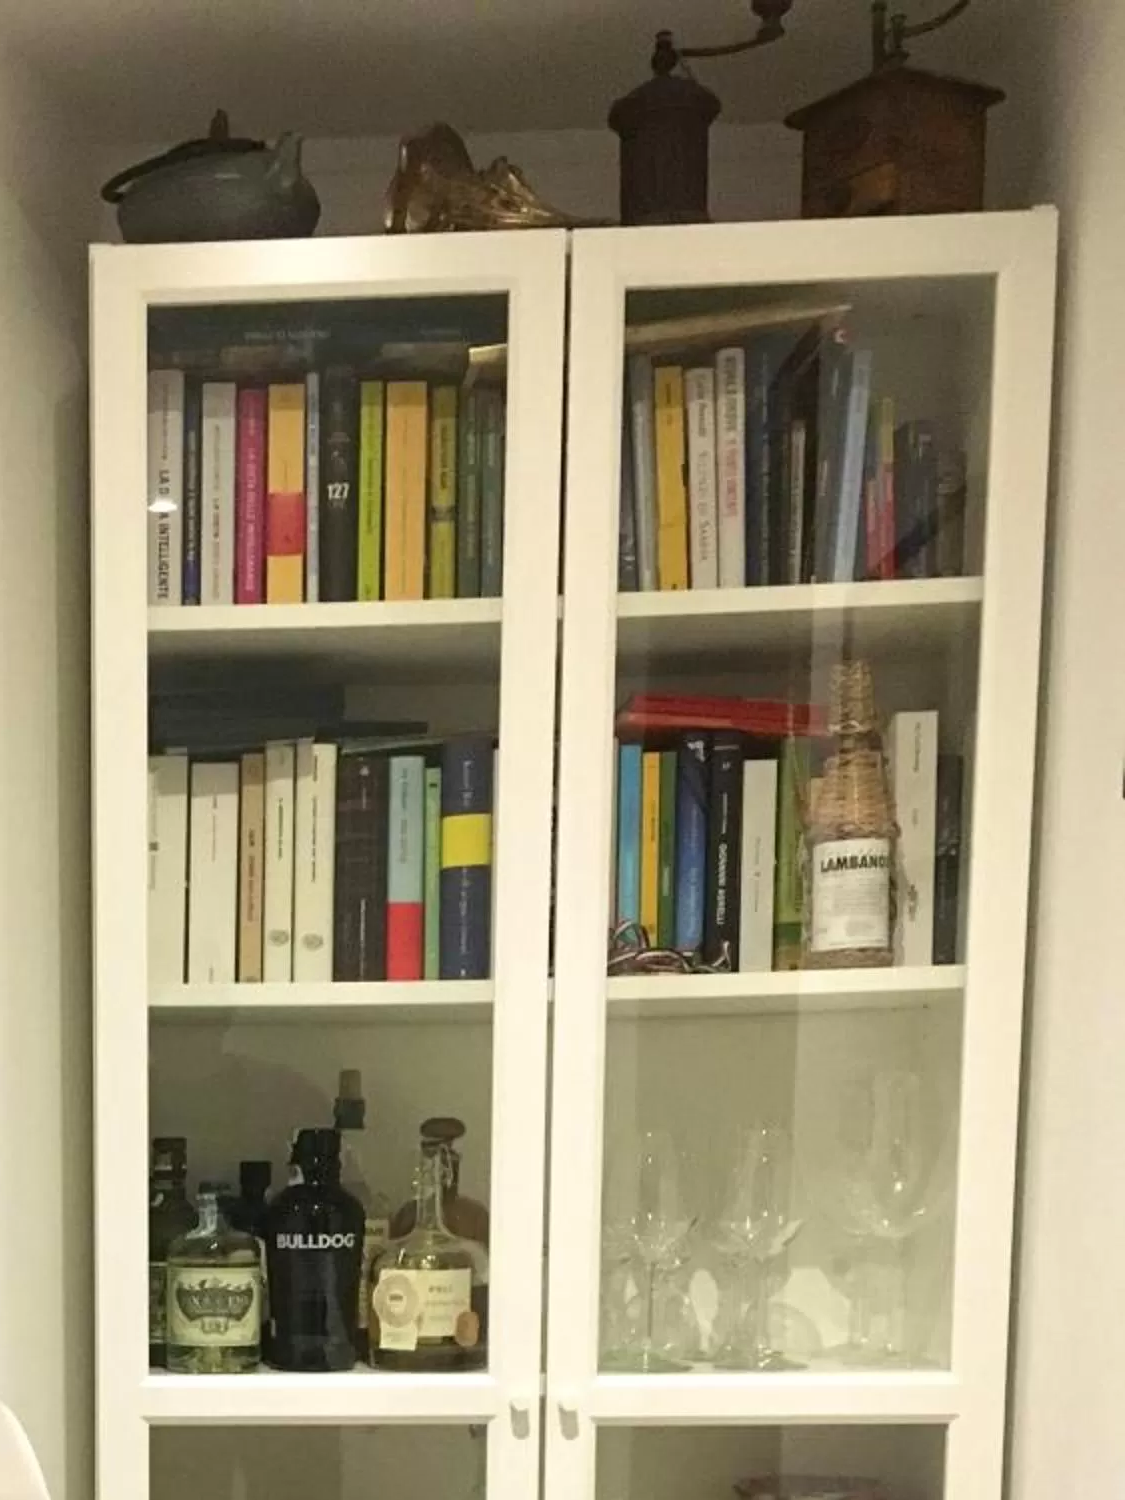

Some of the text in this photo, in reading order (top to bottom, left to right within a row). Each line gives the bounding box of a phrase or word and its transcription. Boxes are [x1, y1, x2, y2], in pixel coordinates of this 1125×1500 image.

[327, 483, 350, 501] 127
[157, 523, 170, 599] INTELLIGENTE
[276, 1232, 356, 1250] BULLDOG
